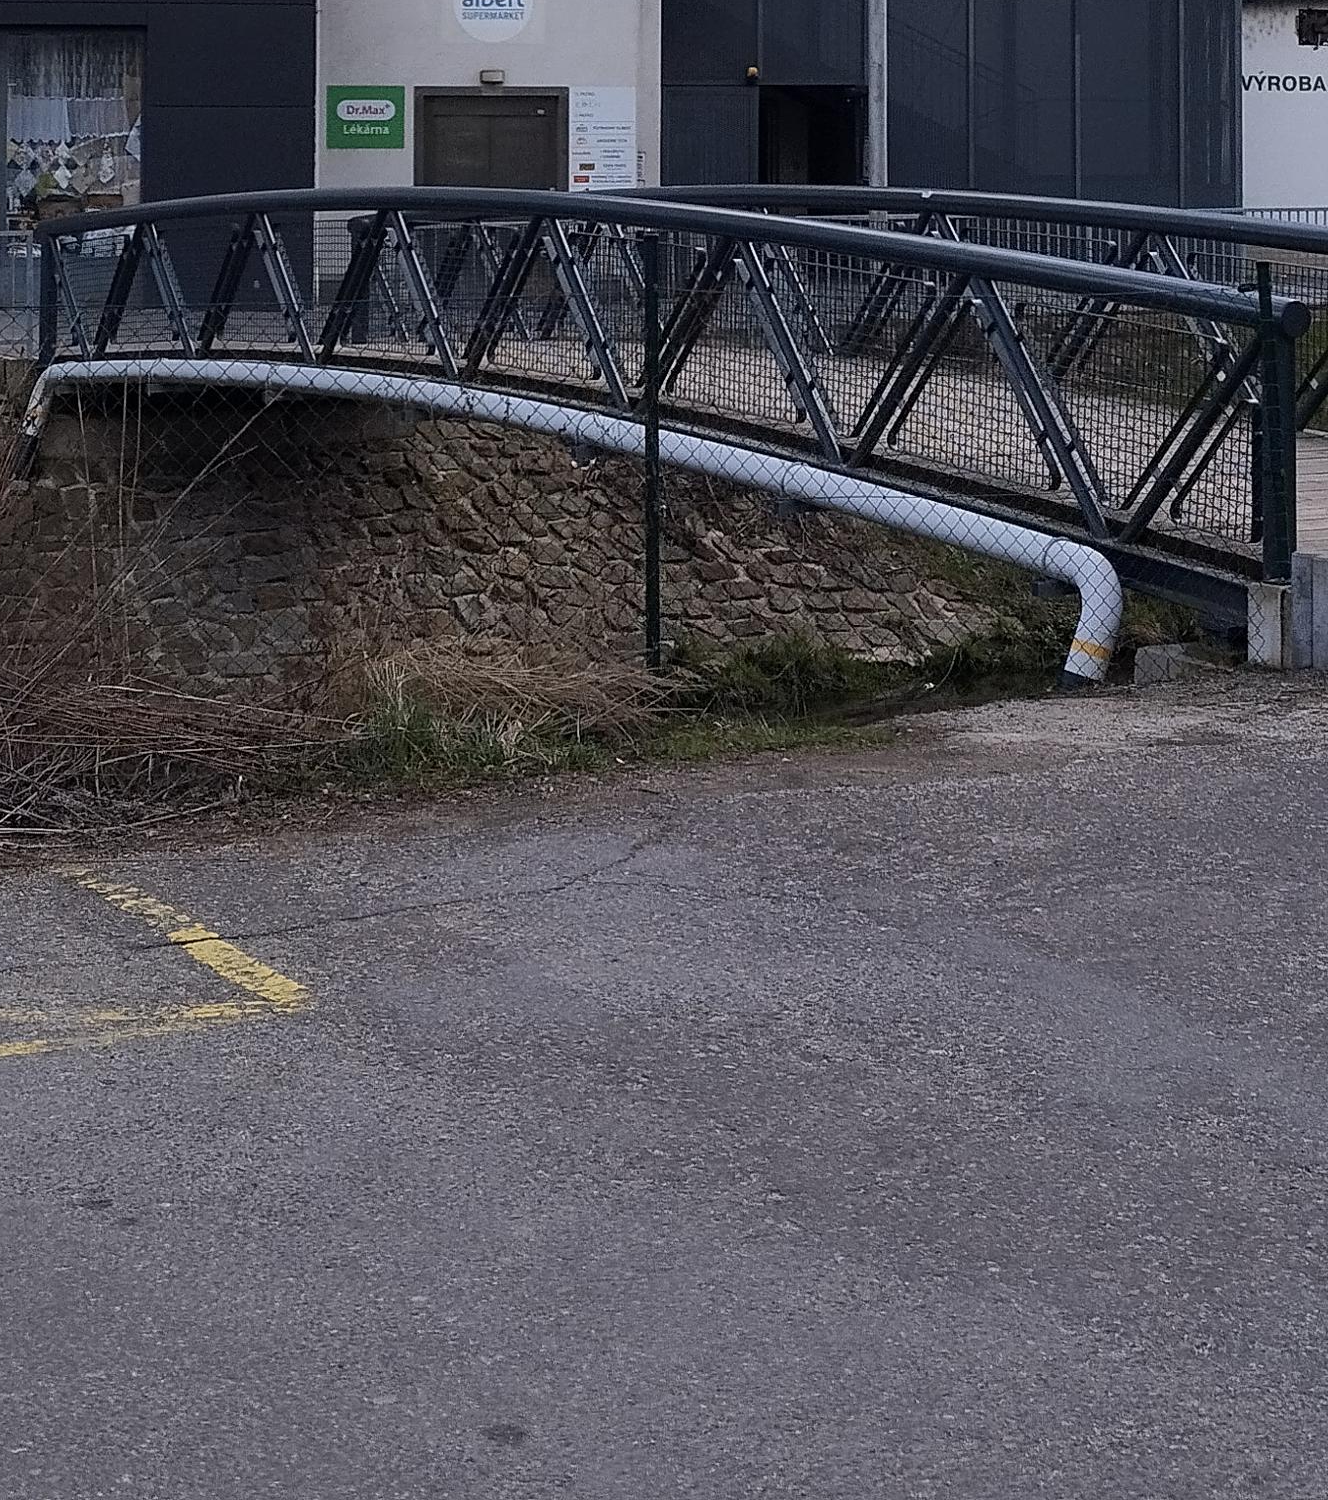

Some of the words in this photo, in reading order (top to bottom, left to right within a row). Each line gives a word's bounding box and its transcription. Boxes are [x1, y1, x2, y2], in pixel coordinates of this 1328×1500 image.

[462, 11, 525, 20] SUPERMARKET
[1242, 70, 1327, 92] VÝROBA
[346, 105, 386, 115] Dr.Max
[343, 124, 390, 135] Lékárna
